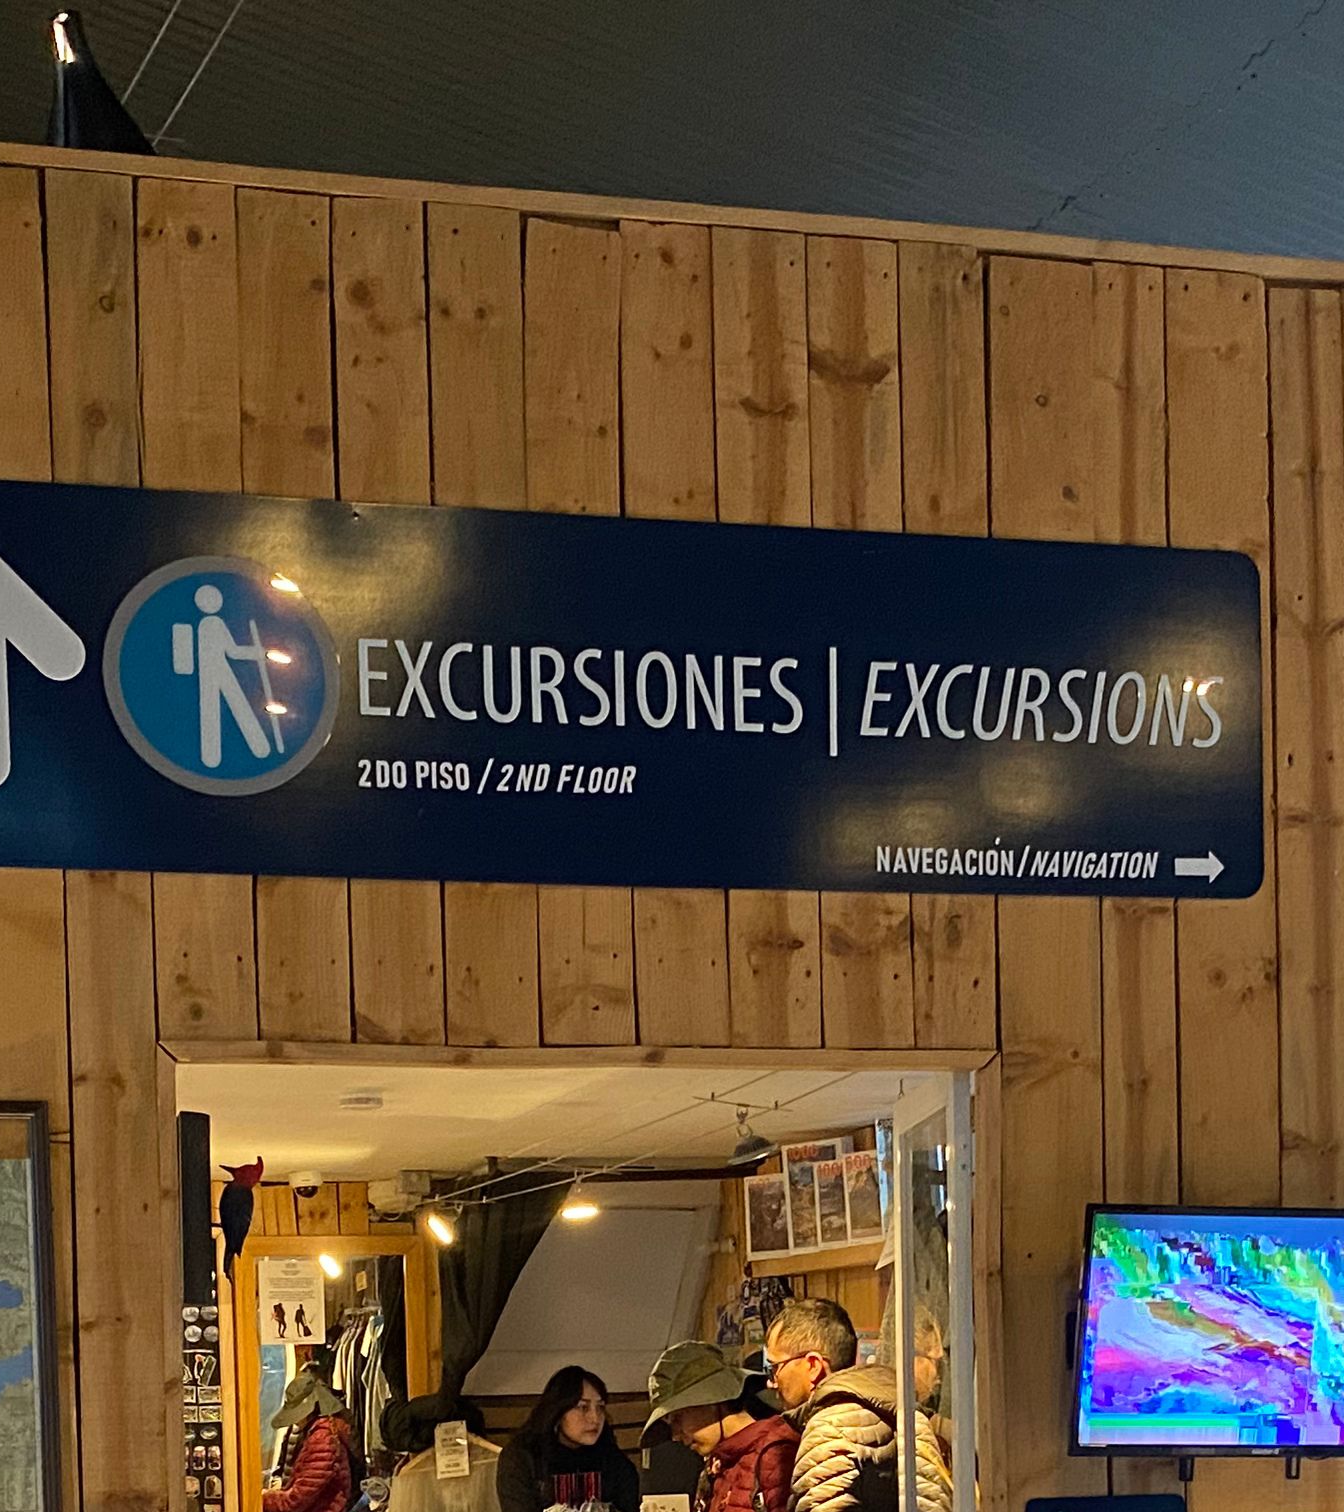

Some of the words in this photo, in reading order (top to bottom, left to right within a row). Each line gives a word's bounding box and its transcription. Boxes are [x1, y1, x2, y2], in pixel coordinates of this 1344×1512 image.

[358, 638, 804, 734] EXCURSIONES
[859, 661, 1224, 749] EXCURSIONS
[415, 760, 471, 792] PISO
[496, 763, 551, 793] 2ND
[556, 764, 638, 795] FLOOR
